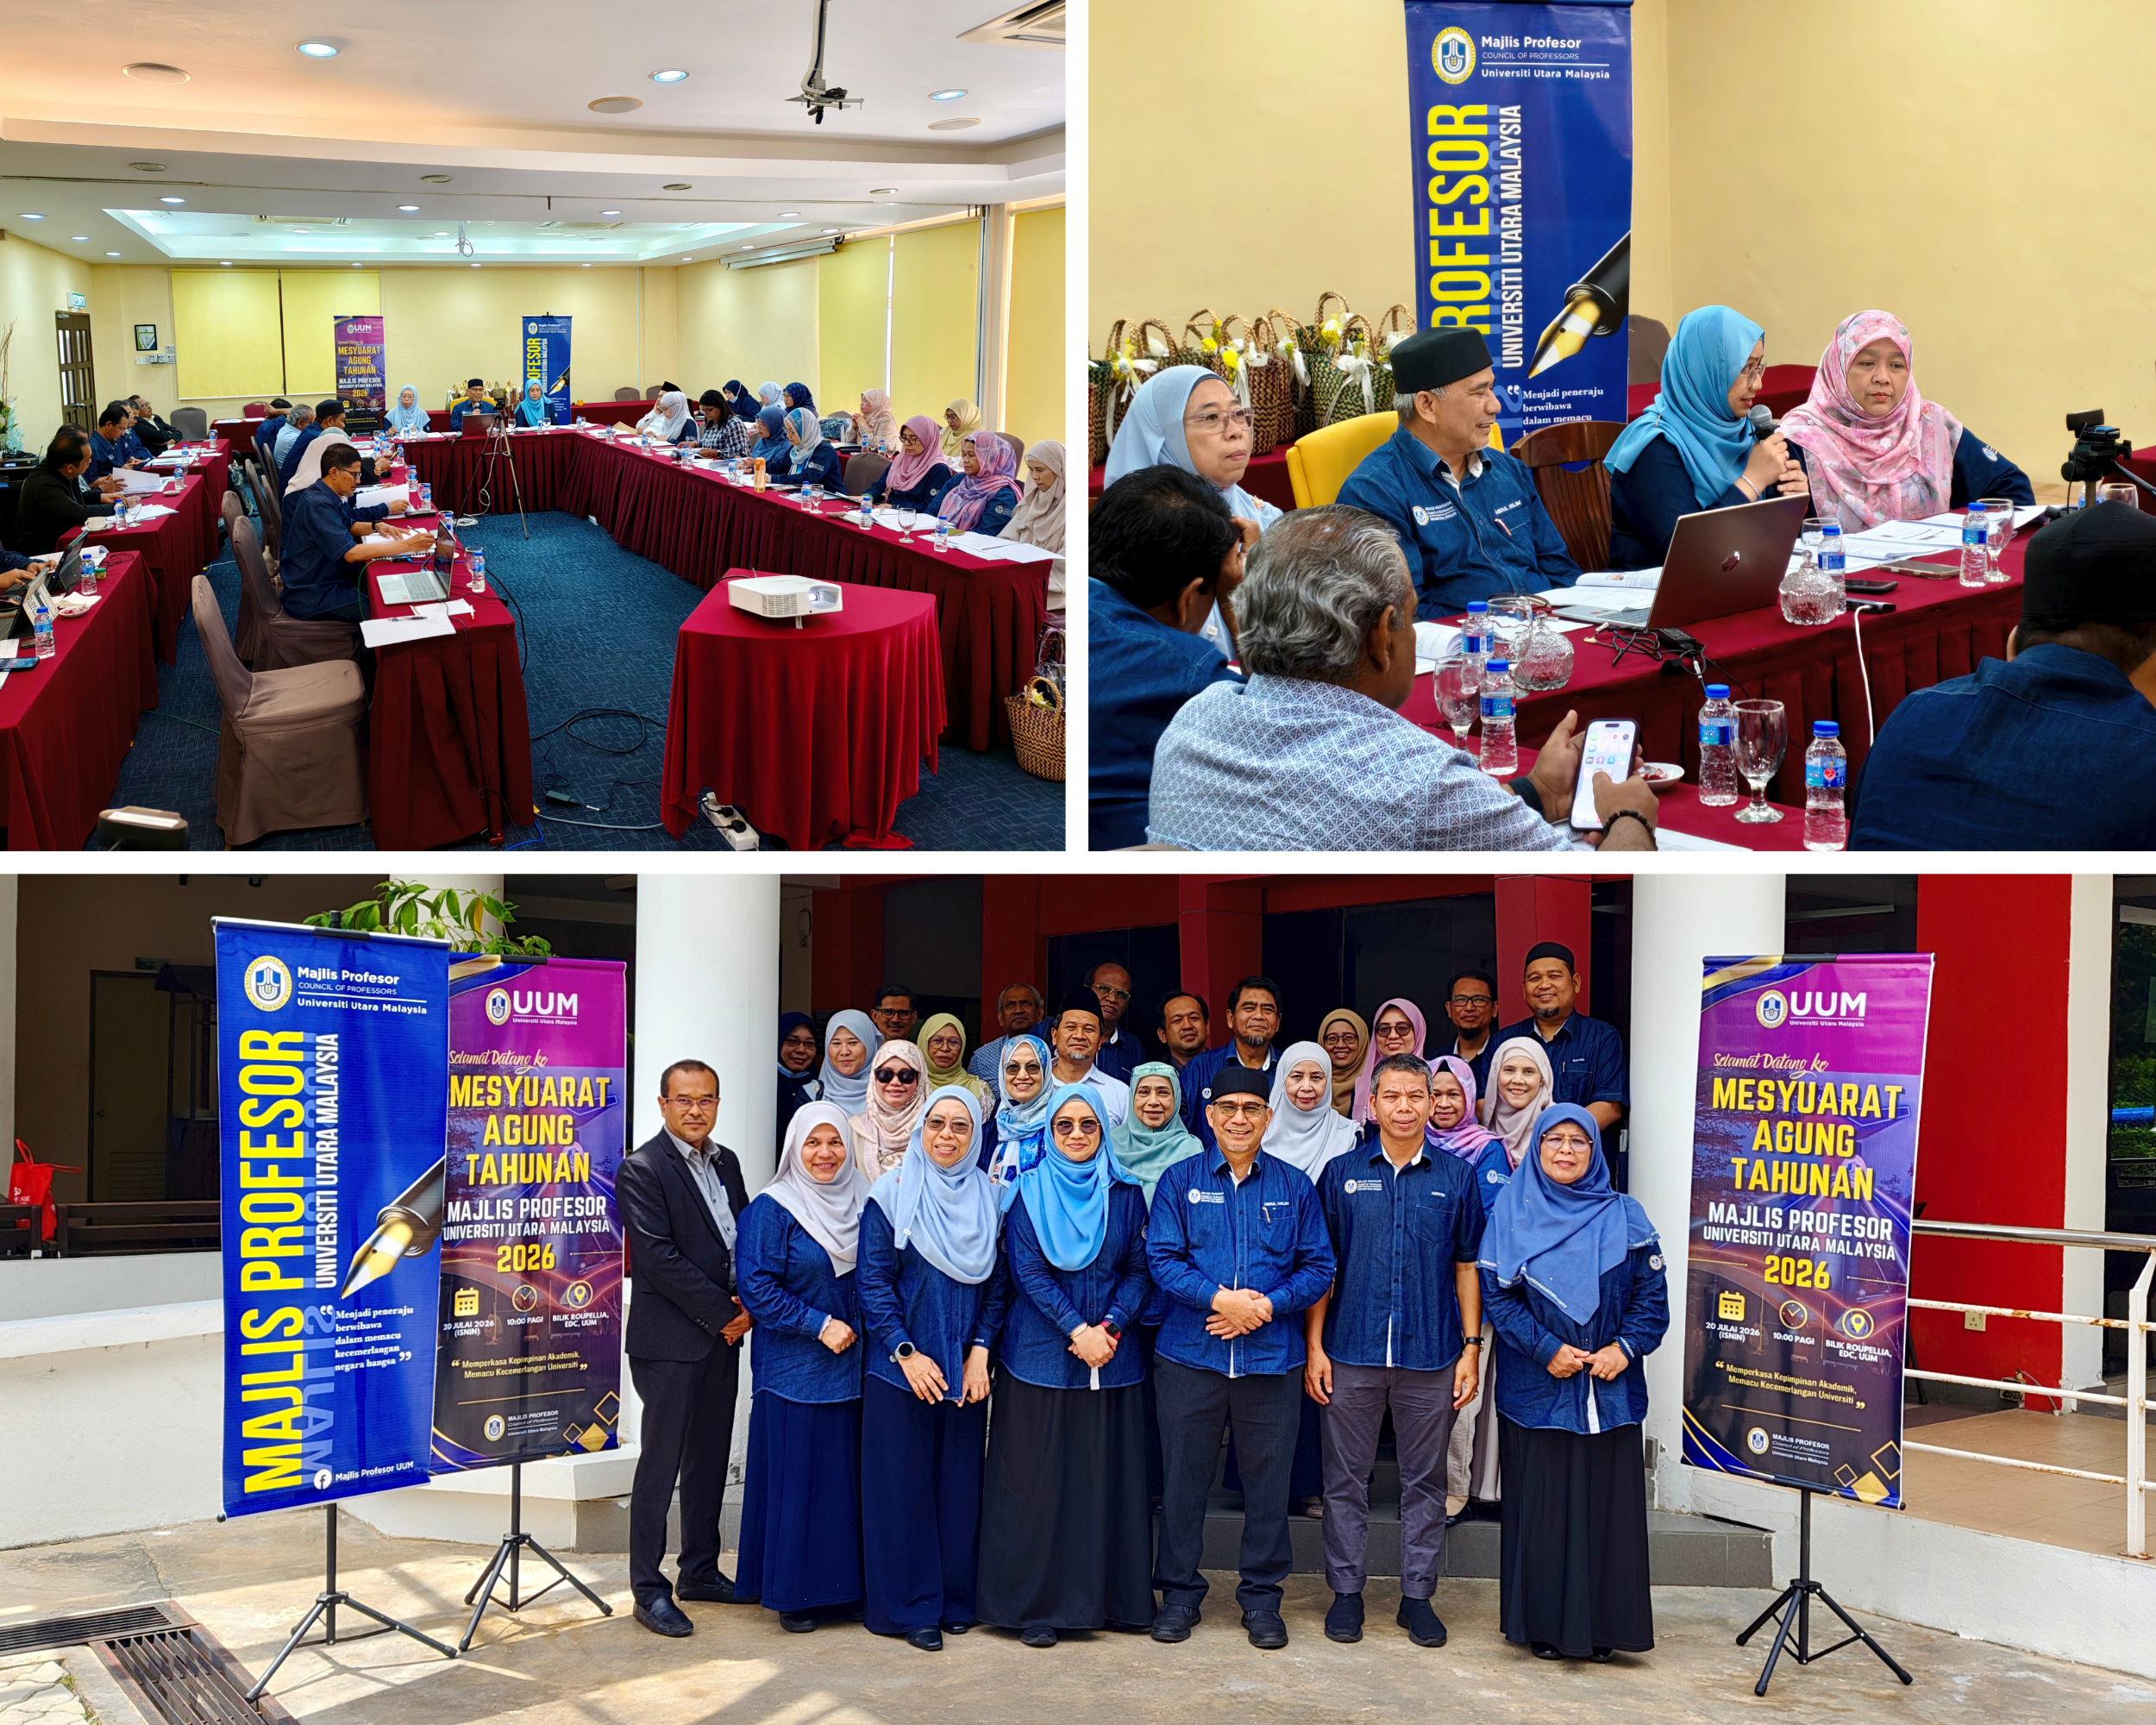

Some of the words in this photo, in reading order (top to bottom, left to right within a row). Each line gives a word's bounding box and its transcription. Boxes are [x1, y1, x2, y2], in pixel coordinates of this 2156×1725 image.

[1482, 35, 1520, 49] Majlis
[1524, 36, 1582, 49] Profesor
[1481, 68, 1531, 78] Universiti
[1533, 69, 1562, 78] Utara
[1565, 69, 1610, 80] Malaysia
[1499, 104, 1522, 201] MALAYSIA
[1427, 104, 1491, 336] ROFESOR
[1500, 204, 1523, 264] UTARA
[1501, 267, 1524, 368] UNIVERSITI
[338, 347, 381, 355] MESYUARAT
[348, 356, 372, 365] AGUNG
[527, 338, 541, 380] OFESOR
[1522, 389, 1559, 400] Menjadi
[1561, 386, 1604, 399] peneraju
[1522, 401, 1572, 413] berwibawa
[1522, 416, 1551, 425] dalam
[1553, 414, 1592, 423] memacu
[298, 967, 338, 982] Majlis
[342, 970, 399, 985] Profesor
[298, 982, 333, 991] COUNCIL
[347, 985, 398, 995] PROFESSORS
[298, 998, 348, 1010] Universiti
[351, 1000, 379, 1012] Utara
[382, 1002, 427, 1015] Malaysia
[513, 990, 578, 1016] UUM
[1790, 991, 1866, 1017] UUM
[449, 1050, 490, 1066] Selamat
[491, 1049, 540, 1075] Datang
[533, 1049, 549, 1068] ke
[1713, 1052, 1762, 1069] Selamat
[1762, 1053, 1817, 1080] Datang
[1810, 1052, 1829, 1073] ke
[315, 1033, 339, 1124] MALAYSIA
[448, 1075, 611, 1108] MESYUARAT
[1712, 1076, 1903, 1120] MESYUARAT
[482, 1113, 574, 1146] AGUNG
[1752, 1120, 1855, 1157] AGUNG
[238, 1030, 304, 1292] PROFESOR
[315, 1127, 339, 1186] UTARA
[466, 1151, 590, 1185] TAHUNAN
[1731, 1157, 1874, 1201] TAHUNAN
[447, 1198, 513, 1223] MAJLIS
[519, 1195, 606, 1220] PROFESOR
[442, 1222, 505, 1242] UNIVERSITI
[508, 1221, 547, 1238] UTARA
[549, 1219, 611, 1236] MALAYSIA
[1708, 1201, 1783, 1230] MAJLIS
[1789, 1209, 1893, 1241] PROFESOR
[315, 1190, 338, 1289] UNIVERSITI
[1703, 1225, 1774, 1247] UNIVERSITI
[1777, 1233, 1821, 1253] UTARA
[1825, 1239, 1896, 1261] MALAYSIA
[497, 1242, 555, 1273] 2026
[1764, 1254, 1831, 1290] 2026
[335, 1308, 372, 1320] Menjadi
[373, 1306, 414, 1320] peneraju
[507, 1317, 525, 1327] 10:00
[526, 1315, 544, 1325] PAGI
[552, 1314, 571, 1322] BILIK
[571, 1311, 610, 1321] ROUPELLIA,
[564, 1320, 580, 1329] EDC,
[580, 1318, 598, 1327] UUM
[335, 1321, 382, 1333] berwibawa
[443, 1322, 452, 1331] 20
[452, 1320, 473, 1330] JULAI
[473, 1319, 495, 1328] 2026
[454, 1327, 481, 1339] (ISNIN)
[1705, 1321, 1714, 1331] 20
[1714, 1323, 1739, 1334] JULAI
[1739, 1327, 1761, 1337] 2026
[335, 1334, 363, 1346] dalam
[364, 1332, 402, 1343] memacu
[1719, 1331, 1746, 1343] (ISNIN)
[1772, 1332, 1794, 1343] 10:00
[1794, 1335, 1815, 1346] PAGI
[335, 1344, 400, 1359] kecemerlangan
[1825, 1339, 1846, 1351] BILIK
[1846, 1342, 1893, 1358] ROUPELLIA,
[1839, 1349, 1858, 1361] EDC,
[1858, 1352, 1878, 1363] UUM
[335, 1360, 365, 1372] negara
[366, 1357, 397, 1370] bangsa
[461, 1357, 507, 1370] Memperkasa
[509, 1354, 547, 1367] Kepimpinan
[548, 1351, 581, 1363] Akademik,
[464, 1368, 495, 1379] Memacu
[496, 1364, 547, 1377] Kecemerlangan
[548, 1360, 579, 1371] Universiti
[1726, 1364, 1773, 1381] Memperkasa
[1774, 1371, 1818, 1389] Kepimpinan
[1818, 1378, 1858, 1396] Akademik,
[1728, 1375, 1759, 1388] Memacu
[1760, 1379, 1817, 1398] Kecemerlangan
[1818, 1389, 1854, 1405] Universiti
[240, 1306, 304, 1494] MAJLIS
[507, 1414, 528, 1422] MAJLIS
[528, 1409, 559, 1419] PROFESOR
[1771, 1433, 1795, 1444] MAJLIS
[1795, 1438, 1830, 1450] PROFESOR
[335, 1470, 359, 1483] Majlis
[360, 1464, 395, 1477] Profesor
[396, 1460, 414, 1471] UUM
